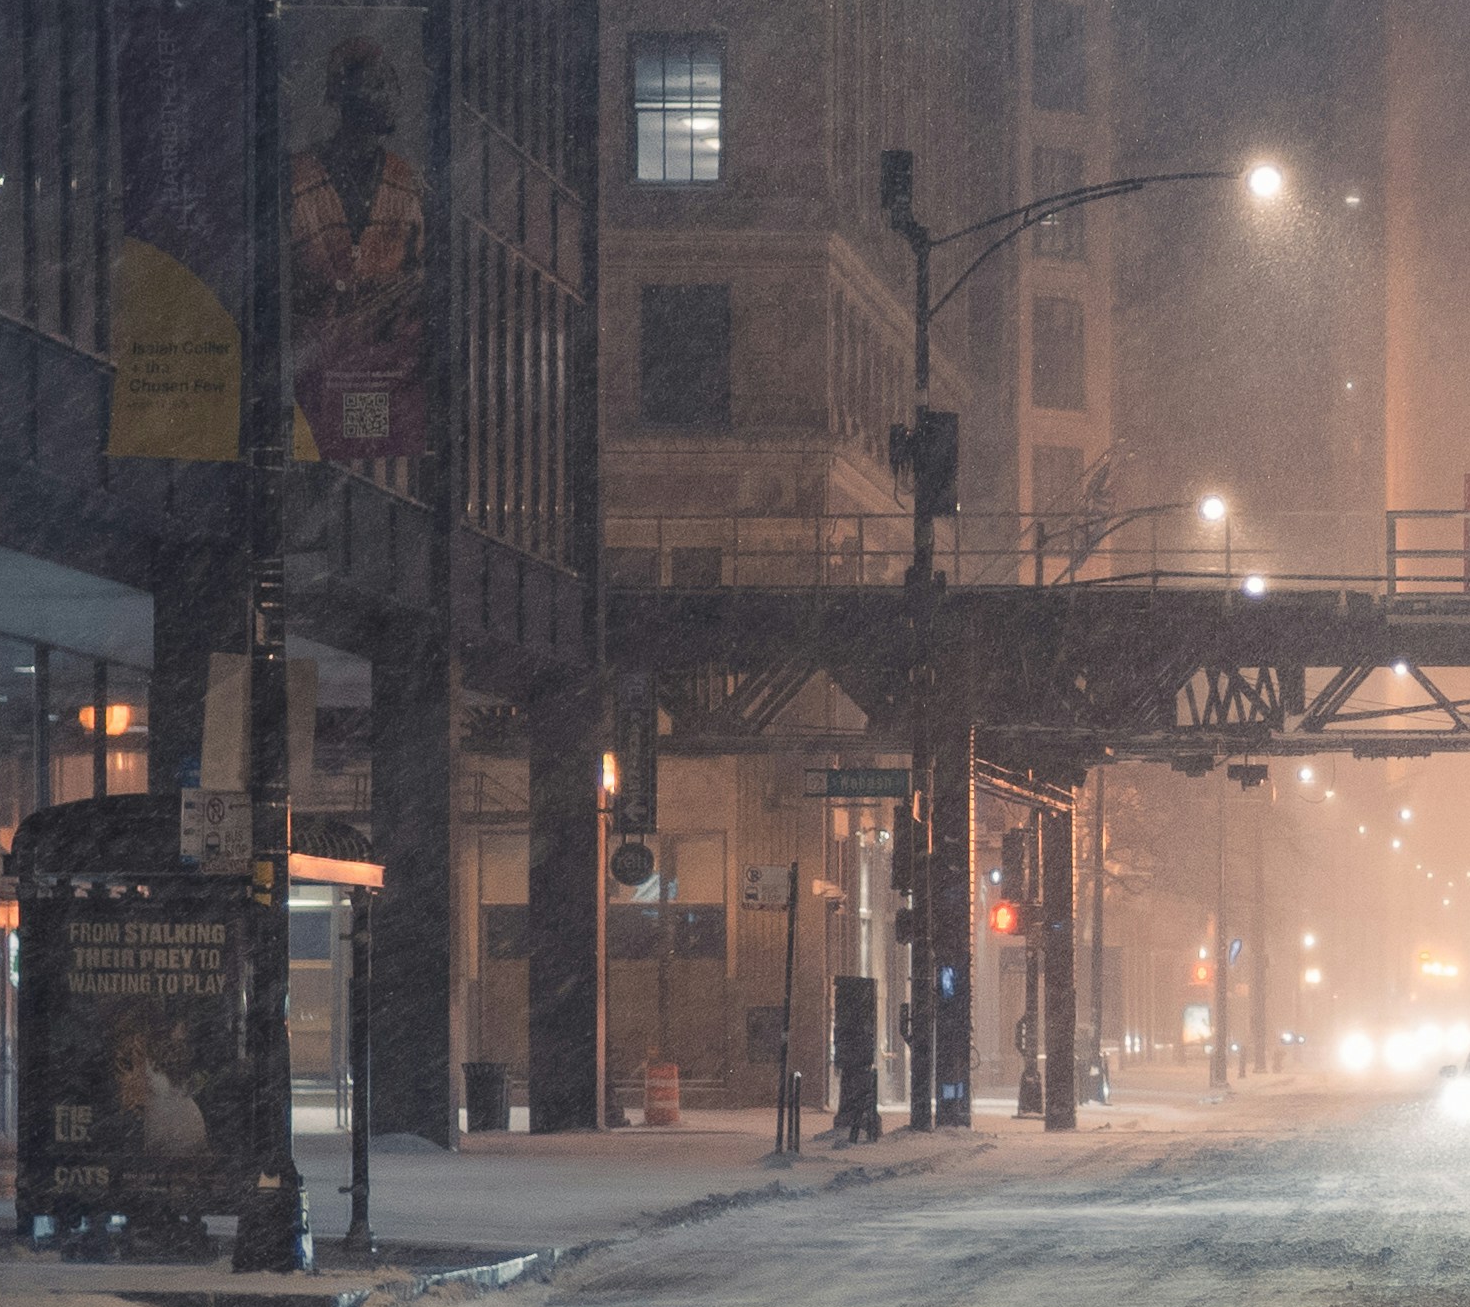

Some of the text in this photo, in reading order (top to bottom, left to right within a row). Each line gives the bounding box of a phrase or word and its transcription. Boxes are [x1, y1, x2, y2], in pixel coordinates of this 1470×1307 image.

[132, 342, 178, 355] Isaiah
[193, 379, 226, 394] Few
[69, 922, 226, 945] FROM STALKING
[74, 948, 220, 969] THEIR PREY TO
[68, 973, 227, 994] WANTING TO PLAY
[53, 1165, 110, 1187] CATS
